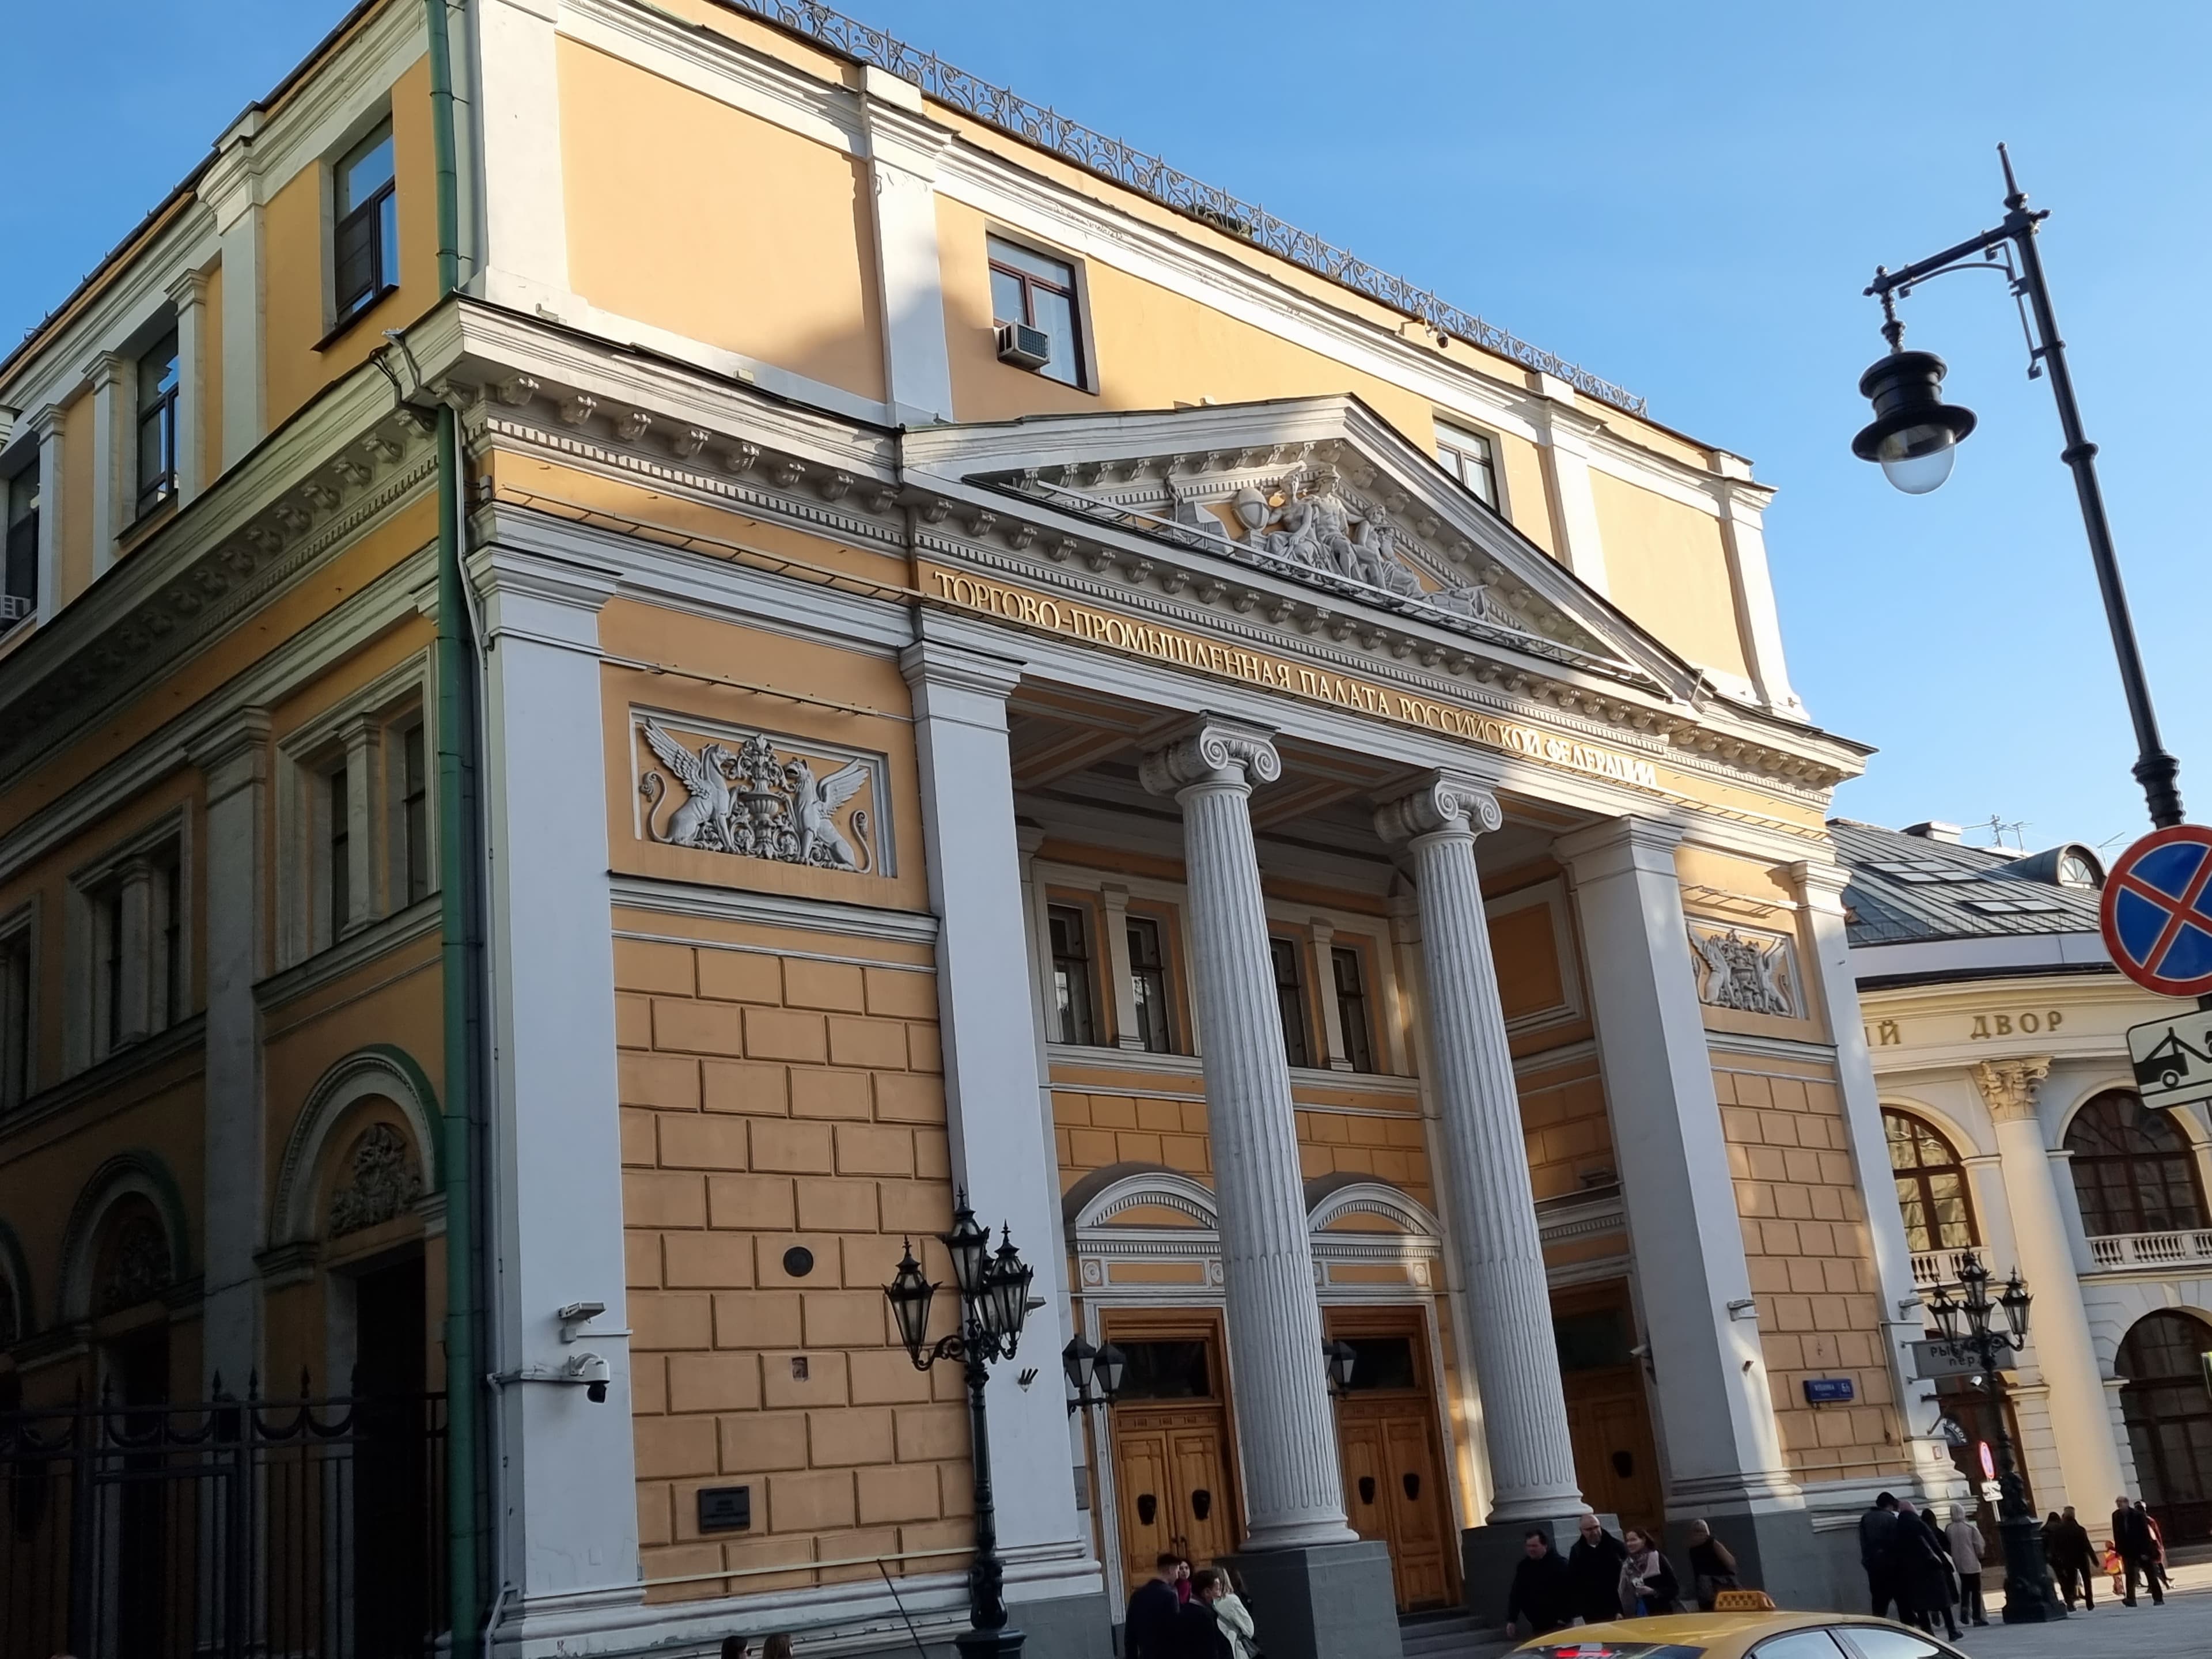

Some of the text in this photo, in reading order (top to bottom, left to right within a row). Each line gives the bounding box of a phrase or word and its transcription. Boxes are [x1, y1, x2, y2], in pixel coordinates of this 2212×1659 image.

[934, 571, 1291, 689] ТОРГОВО-ПРОМЫШЛЕННАЯ
[1298, 669, 1391, 715] ПАЛАТА
[1399, 696, 1542, 755] РОССИЙСКОЙ
[1971, 1010, 2063, 1039] ДВОР
